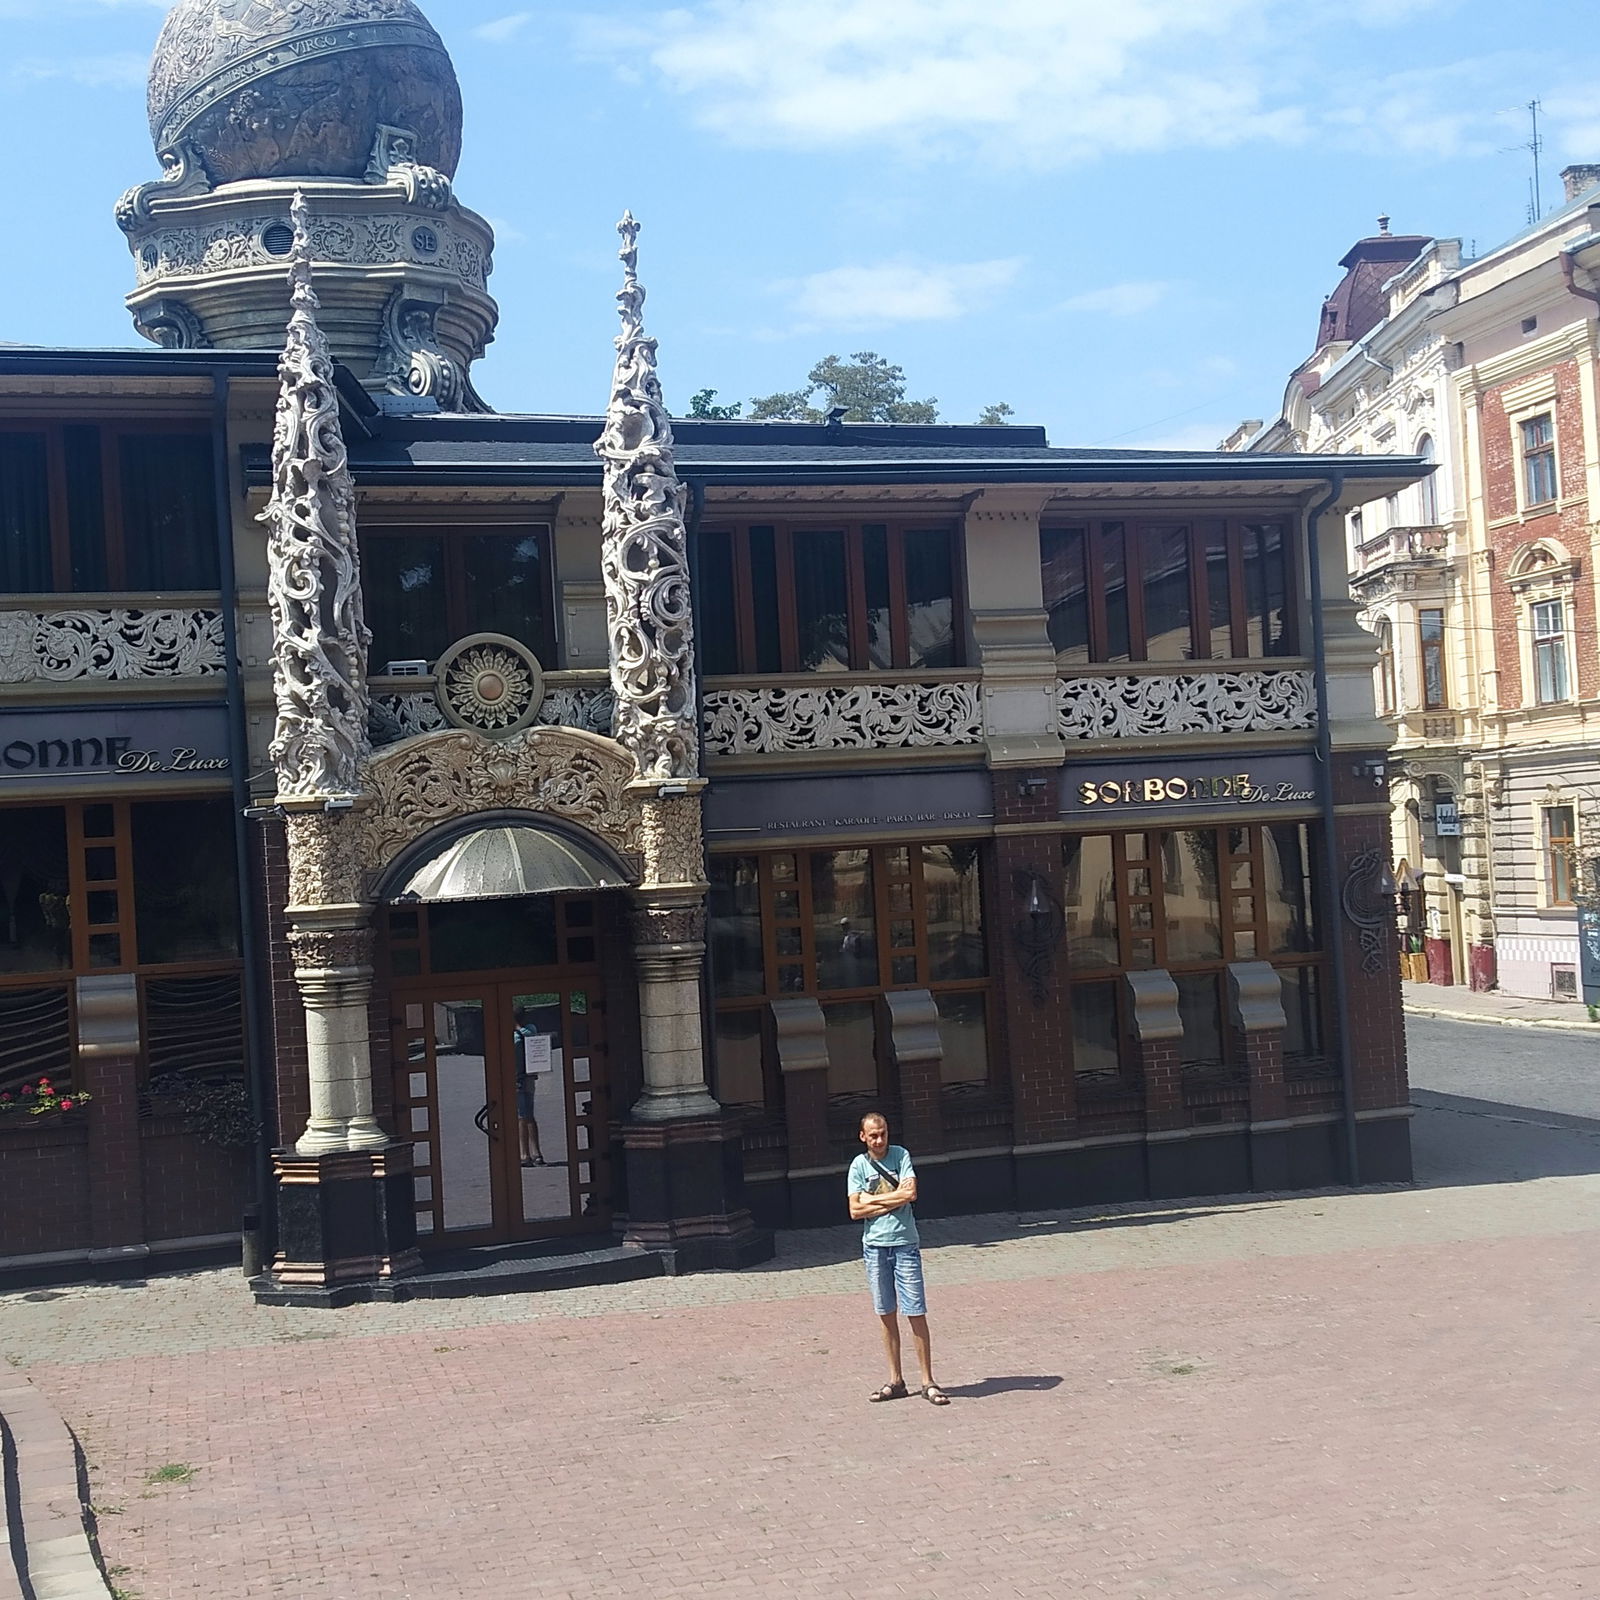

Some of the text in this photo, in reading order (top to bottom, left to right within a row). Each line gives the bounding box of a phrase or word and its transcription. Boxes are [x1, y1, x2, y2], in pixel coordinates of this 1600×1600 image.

[289, 35, 336, 57] VIRGO
[414, 234, 435, 251] SE
[0, 737, 230, 773] ONNE De Luxe
[1239, 784, 1270, 803] De
[1271, 782, 1315, 801] Luxe
[767, 819, 826, 830] RESTAURANT
[886, 814, 914, 823] PARTY
[917, 812, 935, 822] BAR
[943, 811, 970, 820] DISCO
